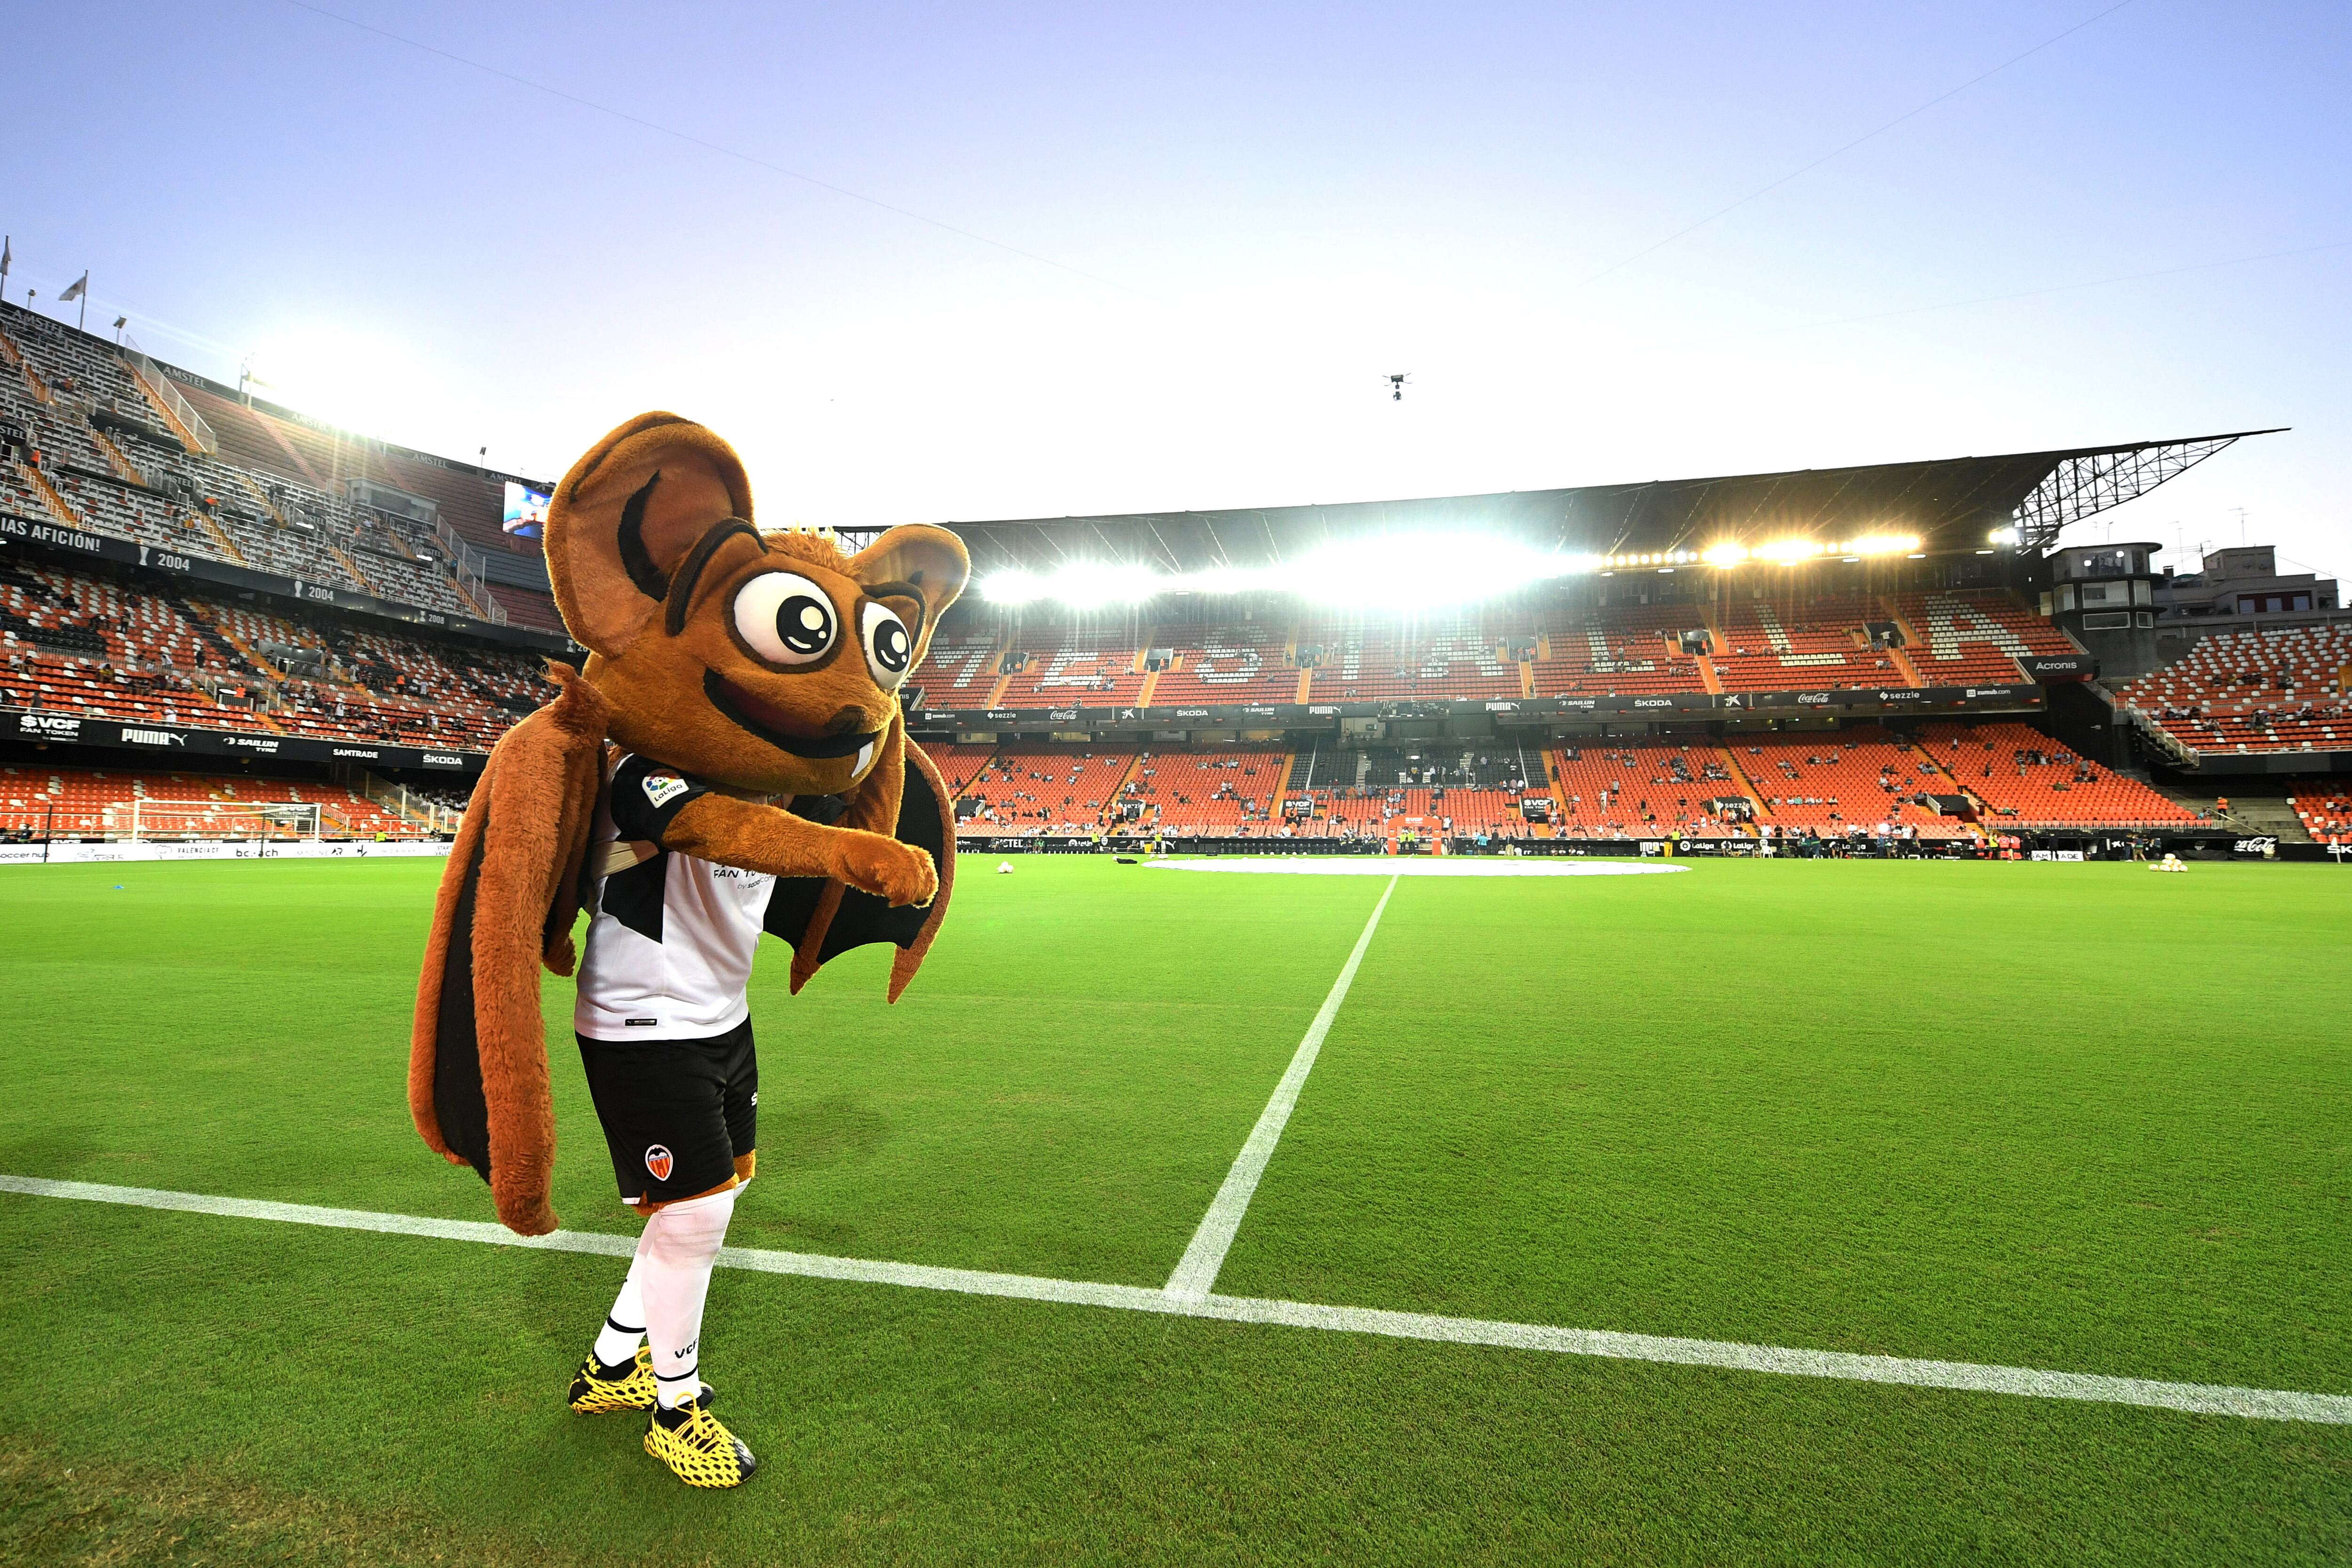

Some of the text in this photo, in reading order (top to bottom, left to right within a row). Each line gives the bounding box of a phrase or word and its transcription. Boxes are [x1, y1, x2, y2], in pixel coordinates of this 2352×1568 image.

[163, 366, 206, 388] AMSTEL
[292, 413, 330, 432] AMSTEL
[413, 453, 447, 467] AMSTEL
[489, 472, 522, 484] AMSTEL
[31, 524, 101, 552] AFICIÓN!
[158, 553, 190, 571] 2004
[309, 586, 334, 601] 2004
[429, 614, 445, 625] 2008
[2036, 662, 2077, 670] Acronis
[1309, 706, 1333, 714] PUMA
[1486, 702, 1511, 711] PUMA
[20, 715, 81, 729] $VCF
[121, 729, 171, 745] PUMA
[237, 739, 279, 748] SAILUN
[333, 748, 379, 759] SAMTRADE
[423, 753, 463, 765] ŠKODA
[654, 784, 683, 802] LaLiga
[714, 870, 739, 879] FAN
[675, 1337, 698, 1359] VCF
